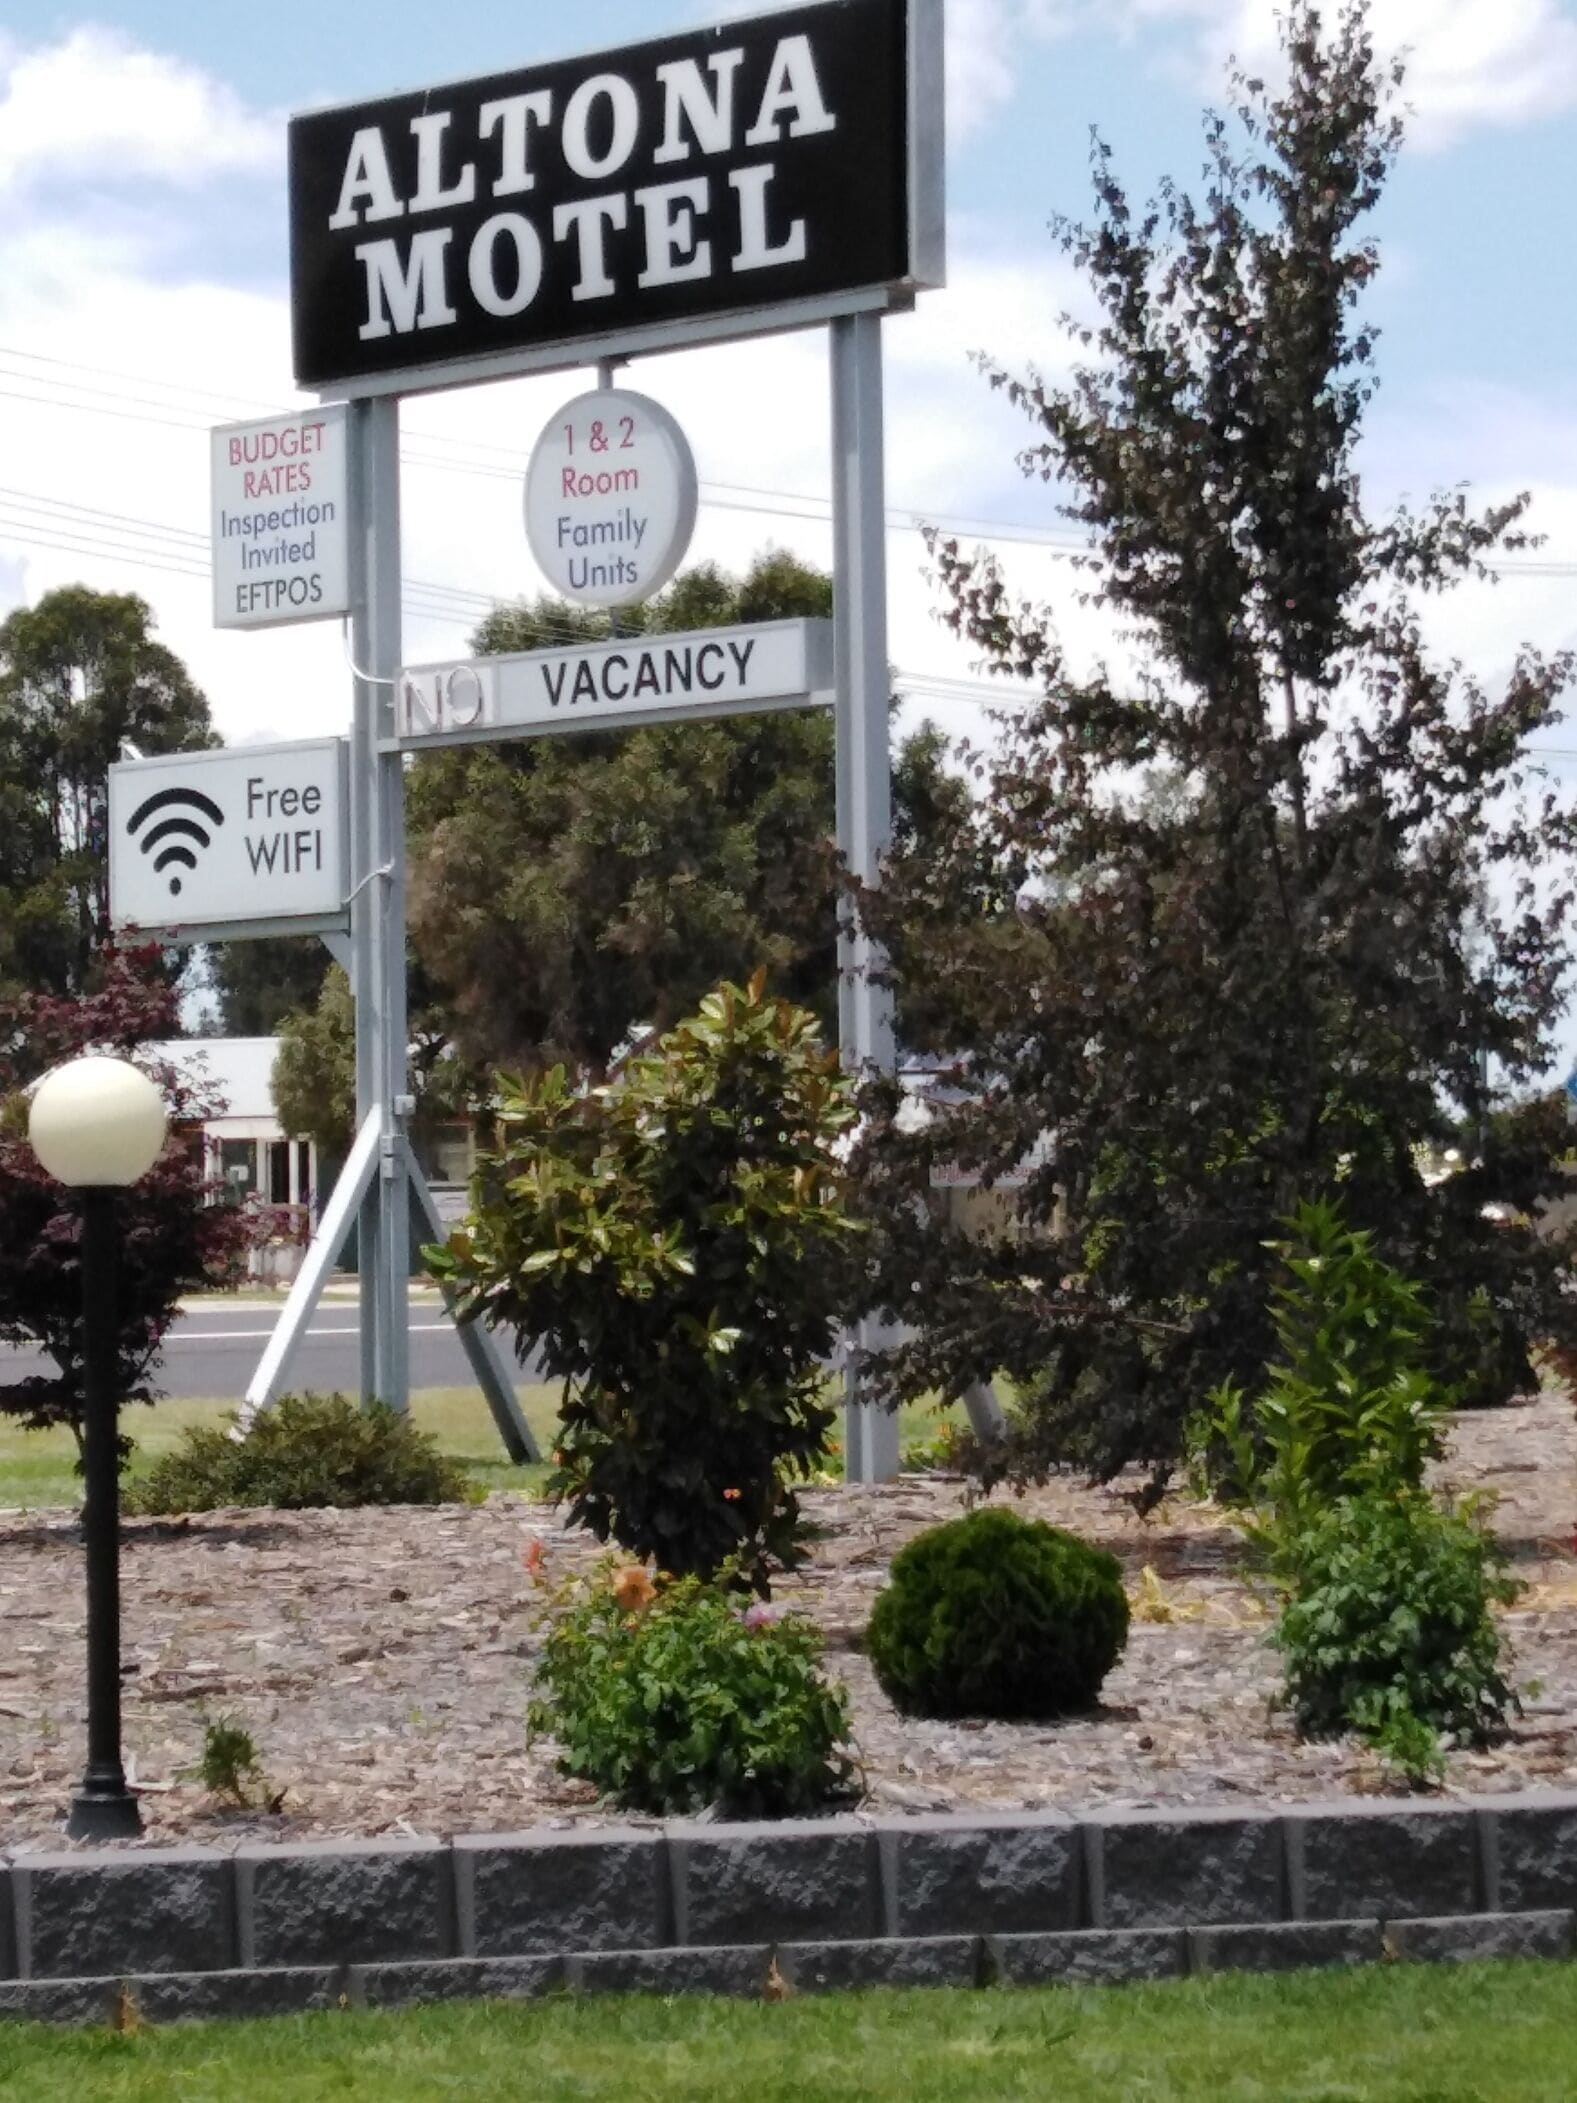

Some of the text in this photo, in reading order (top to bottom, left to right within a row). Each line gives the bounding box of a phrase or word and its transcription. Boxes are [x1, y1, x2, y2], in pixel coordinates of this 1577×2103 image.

[329, 34, 836, 231] ALTONA
[355, 163, 807, 342] MOTEL
[229, 422, 326, 466] BUDGET
[564, 416, 635, 456] 1 & 2
[244, 461, 311, 499] RATES
[562, 466, 639, 498] Room
[221, 498, 335, 540] Inspection
[558, 507, 648, 550] Family
[242, 530, 316, 570] Invited
[569, 554, 638, 589] Units
[236, 573, 323, 613] EFTPOS
[403, 639, 756, 736] NO VACANCY
[246, 777, 321, 819] Free
[244, 829, 322, 876] WIFI
